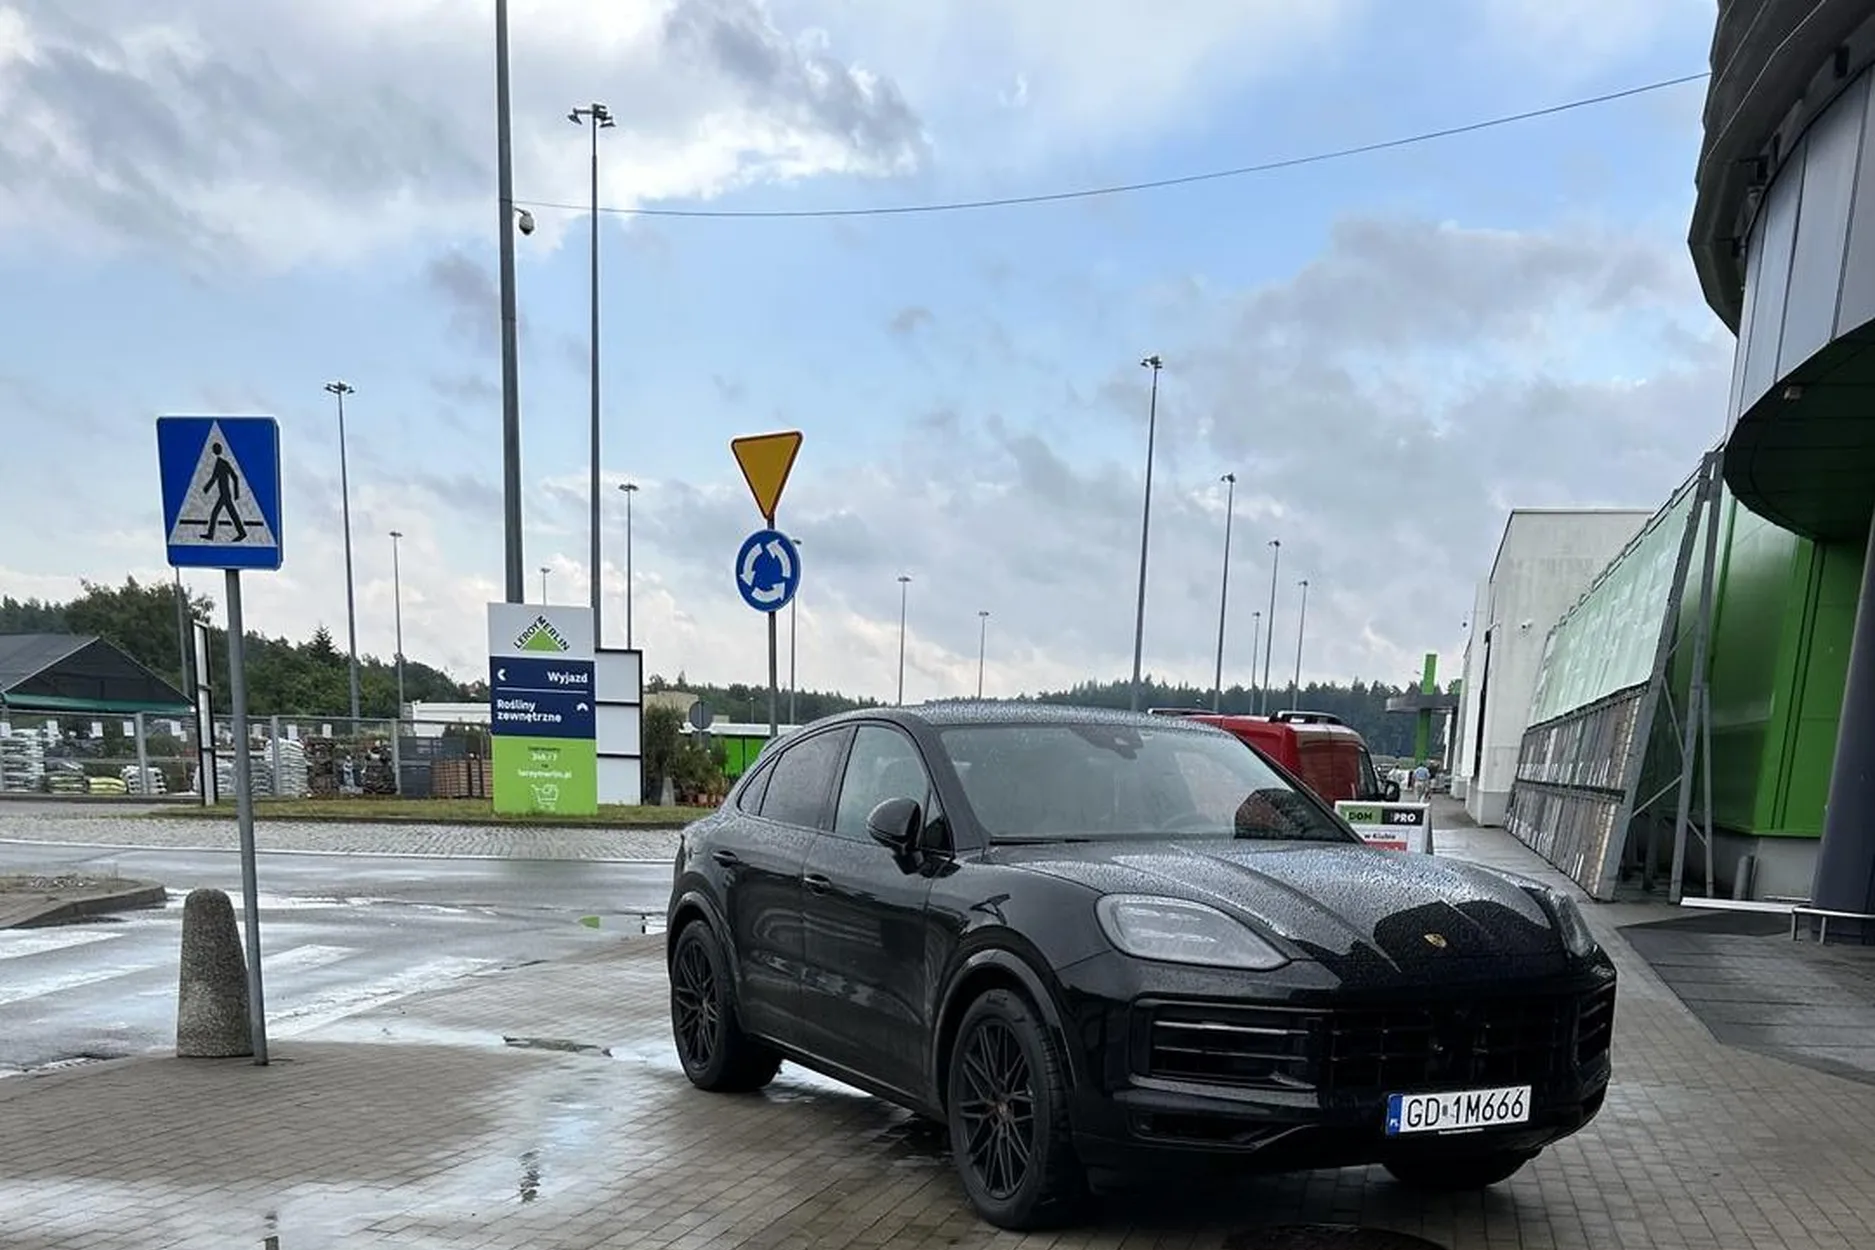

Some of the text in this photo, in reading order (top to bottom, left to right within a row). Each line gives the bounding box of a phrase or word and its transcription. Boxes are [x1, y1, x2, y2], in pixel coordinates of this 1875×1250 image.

[513, 615, 570, 651] LEROY MERLIN
[547, 671, 588, 684] Wyjazd
[497, 699, 536, 713] Rośliny
[497, 712, 562, 723] zewnętrzne
[1348, 812, 1417, 823] DOM PRO
[1407, 1090, 1524, 1128] GD 1M666
